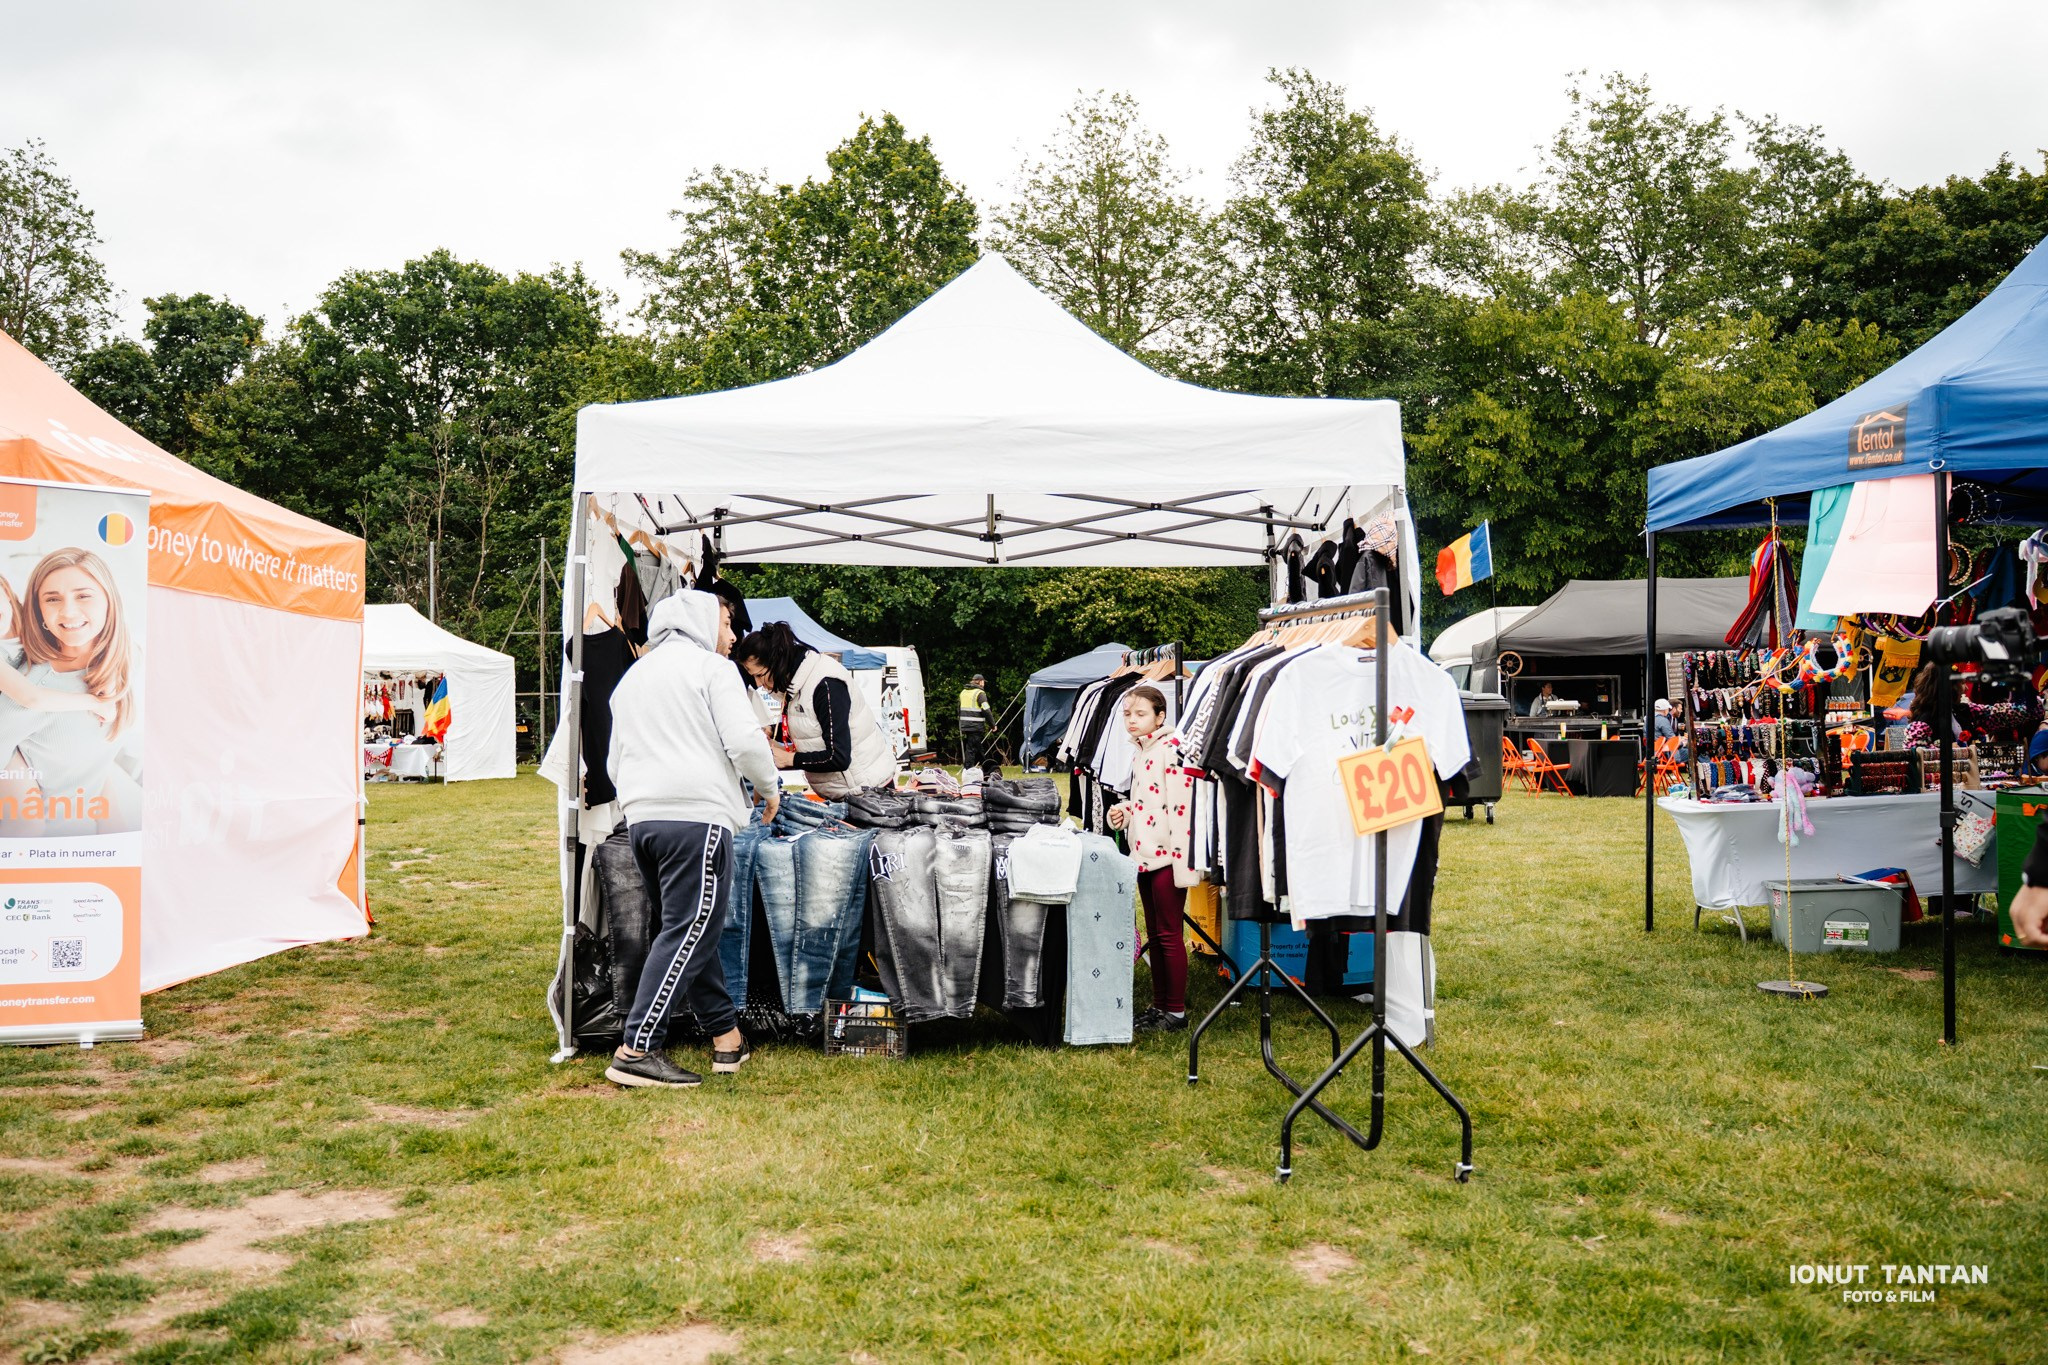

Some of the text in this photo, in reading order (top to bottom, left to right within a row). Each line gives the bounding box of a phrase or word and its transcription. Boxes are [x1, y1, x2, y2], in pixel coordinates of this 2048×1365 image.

[1856, 418, 1894, 453] Tentol
[0, 519, 24, 528] nsfer
[201, 533, 223, 564] to
[226, 539, 281, 578] where
[283, 552, 296, 582] it
[297, 563, 358, 593] matters
[1354, 753, 1427, 821] £20
[29, 849, 56, 858] Plata
[60, 849, 69, 858] in
[72, 849, 116, 858] numerar
[32, 913, 51, 921] Bank
[0, 995, 95, 1008] oneytransfer.com
